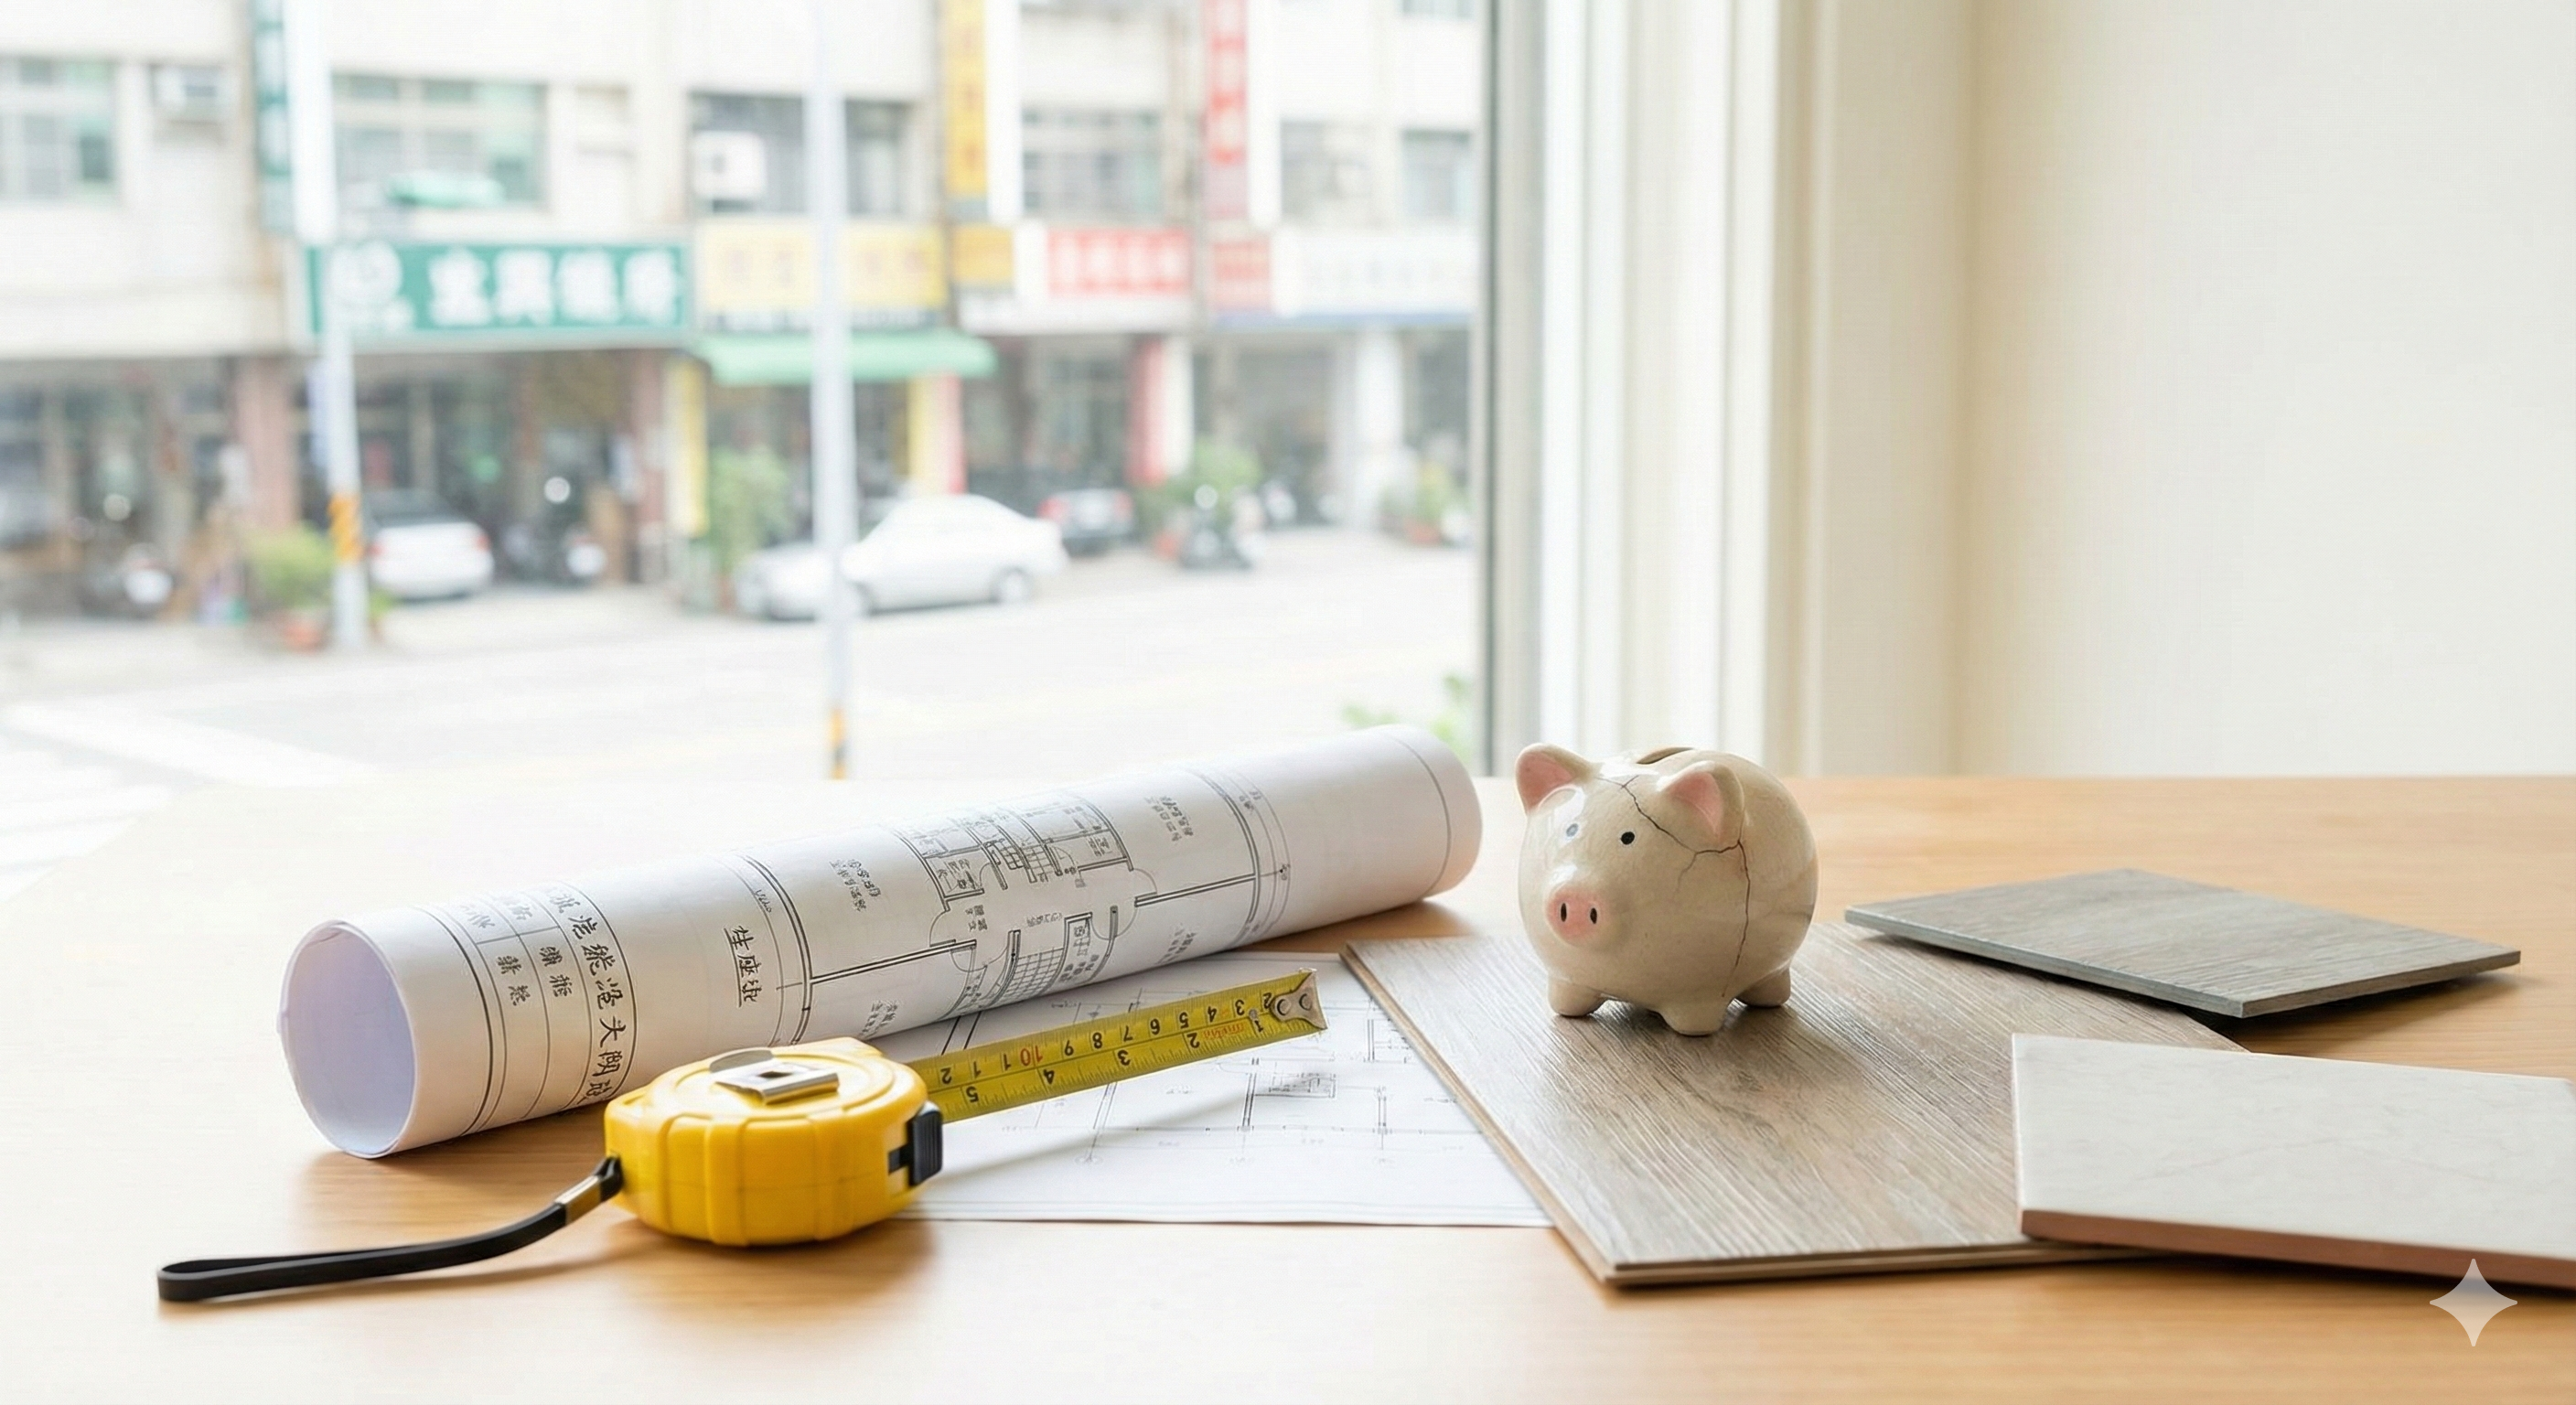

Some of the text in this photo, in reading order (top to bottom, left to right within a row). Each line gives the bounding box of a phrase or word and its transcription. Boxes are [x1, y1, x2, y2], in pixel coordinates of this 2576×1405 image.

[1235, 999, 1245, 1016] 3
[1262, 992, 1272, 1009] 2
[1179, 1012, 1189, 1029] 5
[1208, 1006, 1218, 1023] 4
[1123, 1024, 1133, 1042] 7
[1150, 1018, 1161, 1035] 6
[1254, 1020, 1263, 1033] 1
[1064, 1039, 1074, 1056] 9
[1092, 1032, 1103, 1049] 8
[1186, 1032, 1200, 1049] 2
[1020, 1045, 1043, 1067] 10
[1117, 1049, 1131, 1067] 3
[1043, 1068, 1055, 1085] 4
[965, 1086, 979, 1103] 5
